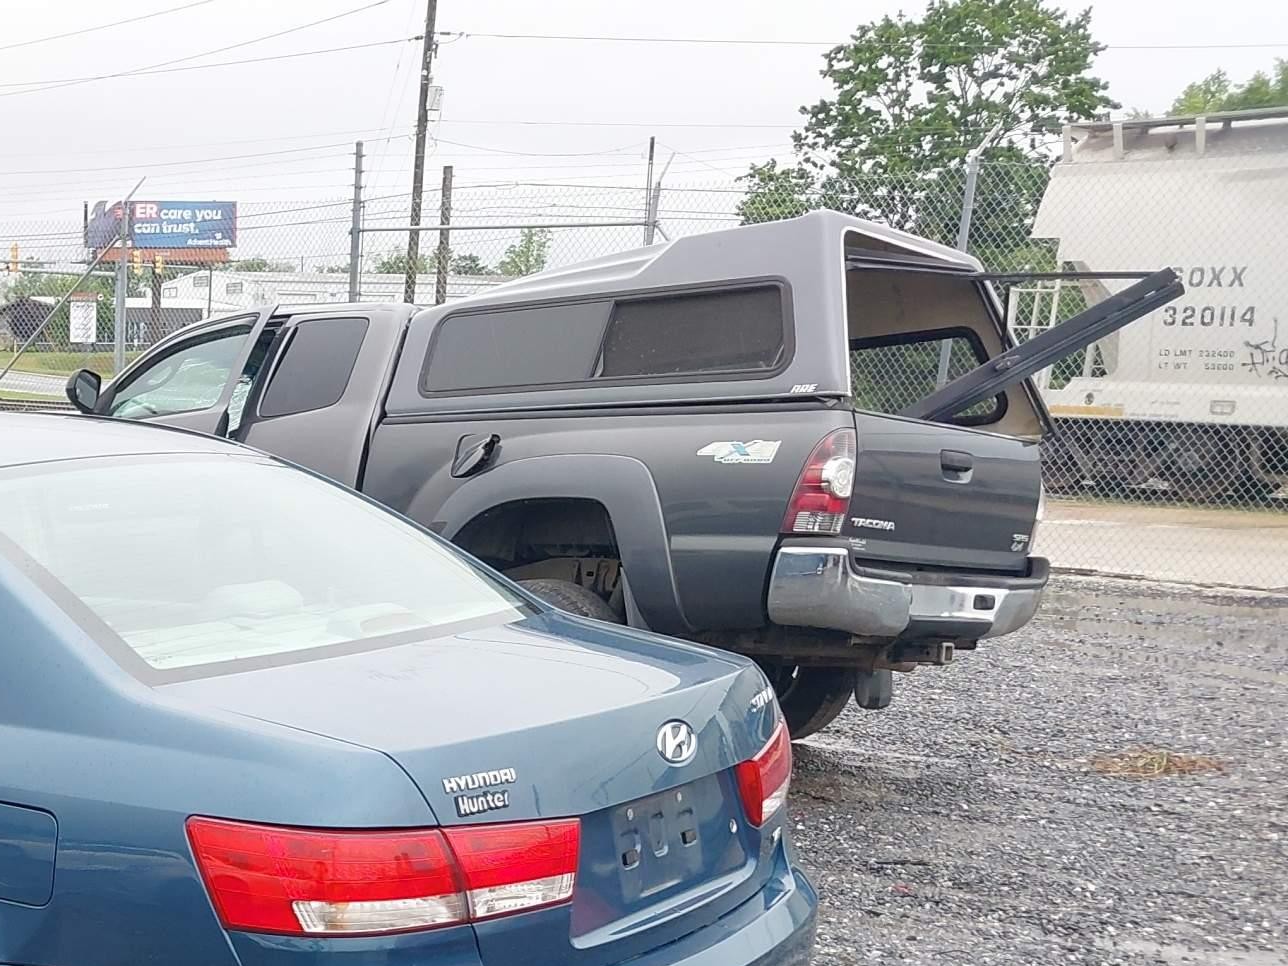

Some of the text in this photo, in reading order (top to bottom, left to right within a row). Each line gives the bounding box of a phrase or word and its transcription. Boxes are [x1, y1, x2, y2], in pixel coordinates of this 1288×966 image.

[136, 203, 222, 222] ER care you
[134, 222, 161, 234] can
[1163, 305, 1256, 327] 320114
[851, 517, 896, 532] TACOMA
[442, 767, 516, 793] HYUNDAI
[457, 791, 509, 815] Hunter
